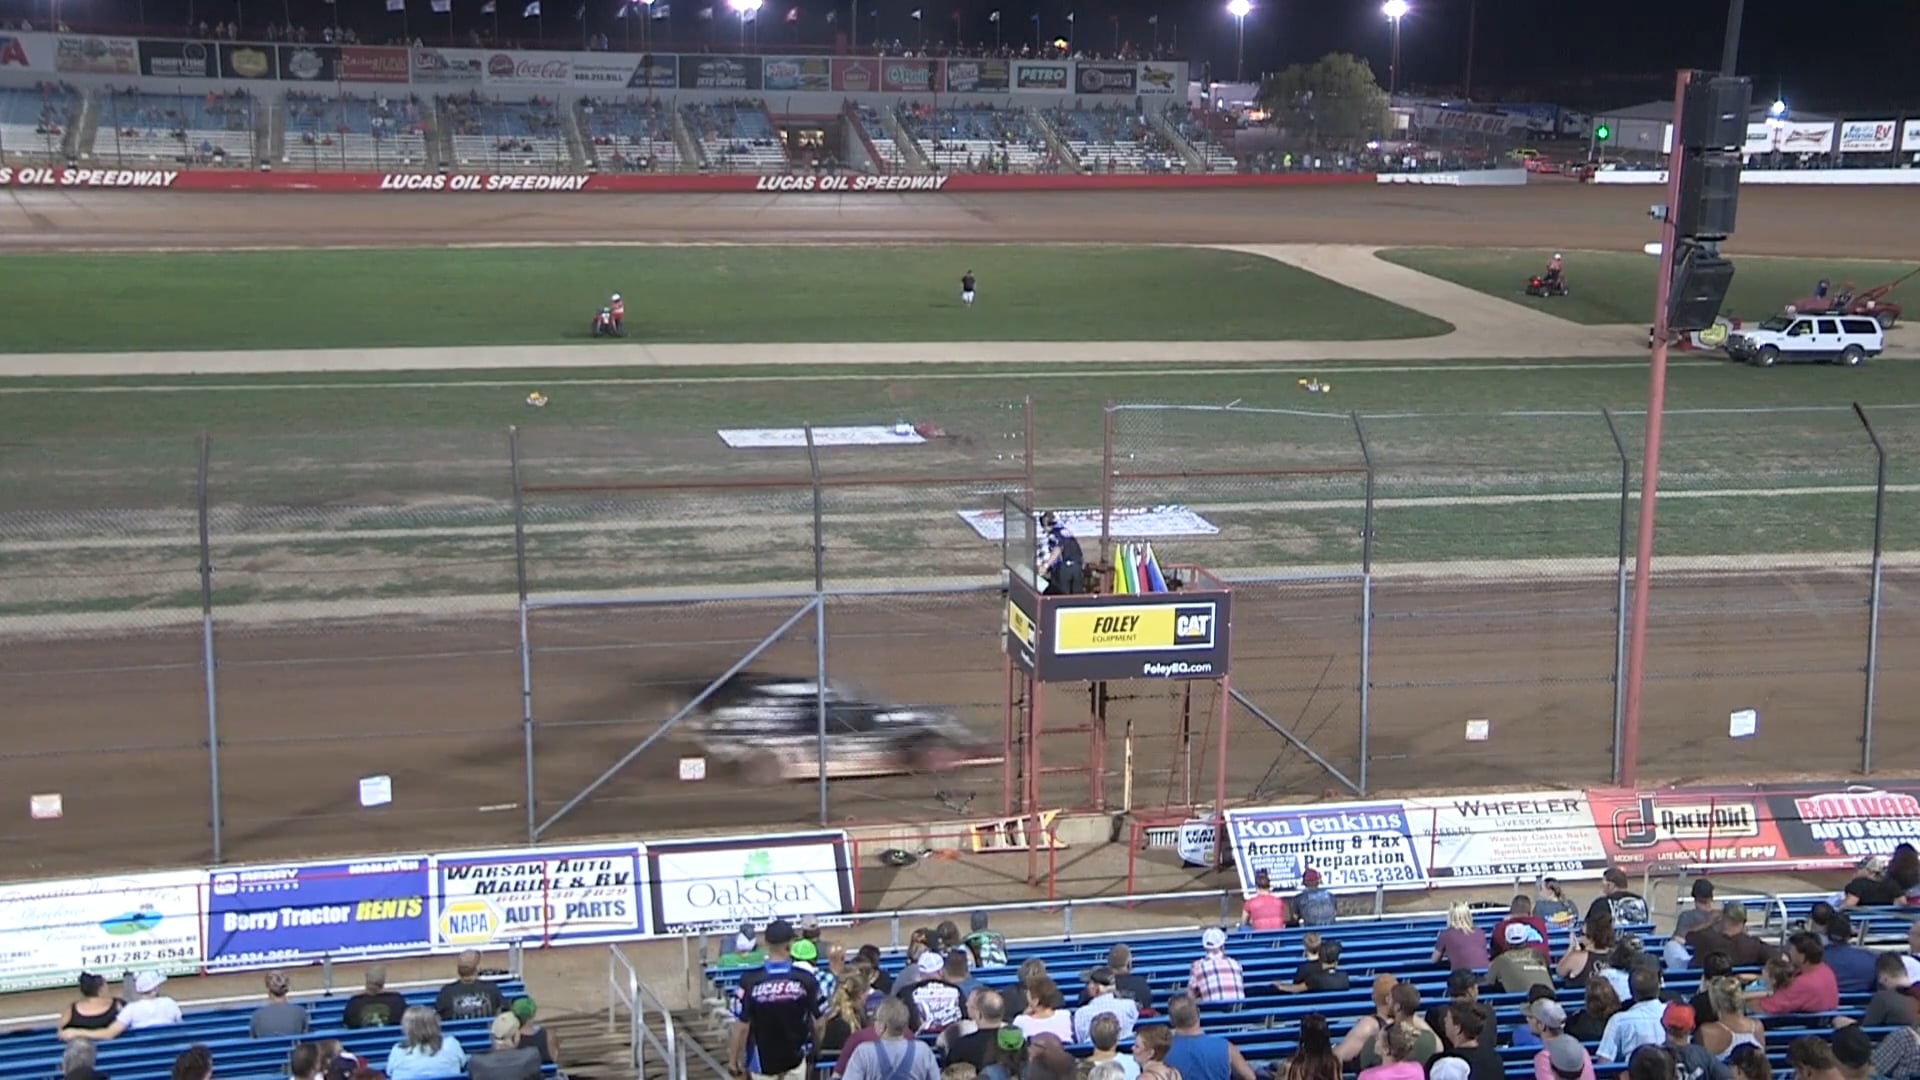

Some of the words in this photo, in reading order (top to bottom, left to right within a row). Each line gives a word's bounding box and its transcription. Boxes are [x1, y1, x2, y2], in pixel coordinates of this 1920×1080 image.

[1020, 69, 1065, 81] PETRO
[18, 168, 56, 185] OIL
[60, 169, 178, 186] SPEEDWAY
[380, 174, 447, 190] LUCAS
[449, 175, 482, 190] OIL
[485, 175, 589, 190] SPEEDWAY
[756, 176, 817, 190] LUCAS
[819, 176, 850, 190] OIL
[852, 176, 948, 190] SPEEDWAY
[1093, 615, 1140, 634] FOLEY
[1176, 615, 1209, 637] CAT
[1092, 633, 1137, 643] EQUIPMENT
[1143, 662, 1212, 678] FoleyEQ.com
[1453, 798, 1581, 818] WHEELER
[1796, 797, 1920, 822] BOLIVAR
[1300, 810, 1402, 839] Jenkins
[1811, 821, 1864, 839] AUTO
[1247, 837, 1345, 857] Accounting
[1351, 835, 1362, 849] &
[1368, 834, 1401, 849] Tax
[1699, 847, 1737, 860] LIVE
[1740, 845, 1777, 859] PPV
[447, 863, 545, 881] WARSAW
[556, 859, 612, 874] AUTO
[1304, 850, 1405, 872] Preparation
[569, 877, 585, 889] &
[595, 871, 629, 887] RV
[1323, 865, 1415, 885] 7-745-2328
[686, 877, 815, 909] OakStar
[223, 911, 278, 933] Berry
[280, 906, 351, 928] Tractor
[355, 895, 424, 922] RENTS
[505, 905, 555, 924] AUTO
[566, 900, 627, 920] PARTS
[449, 913, 488, 935] NAPA
[752, 980, 785, 997] LUCAS
